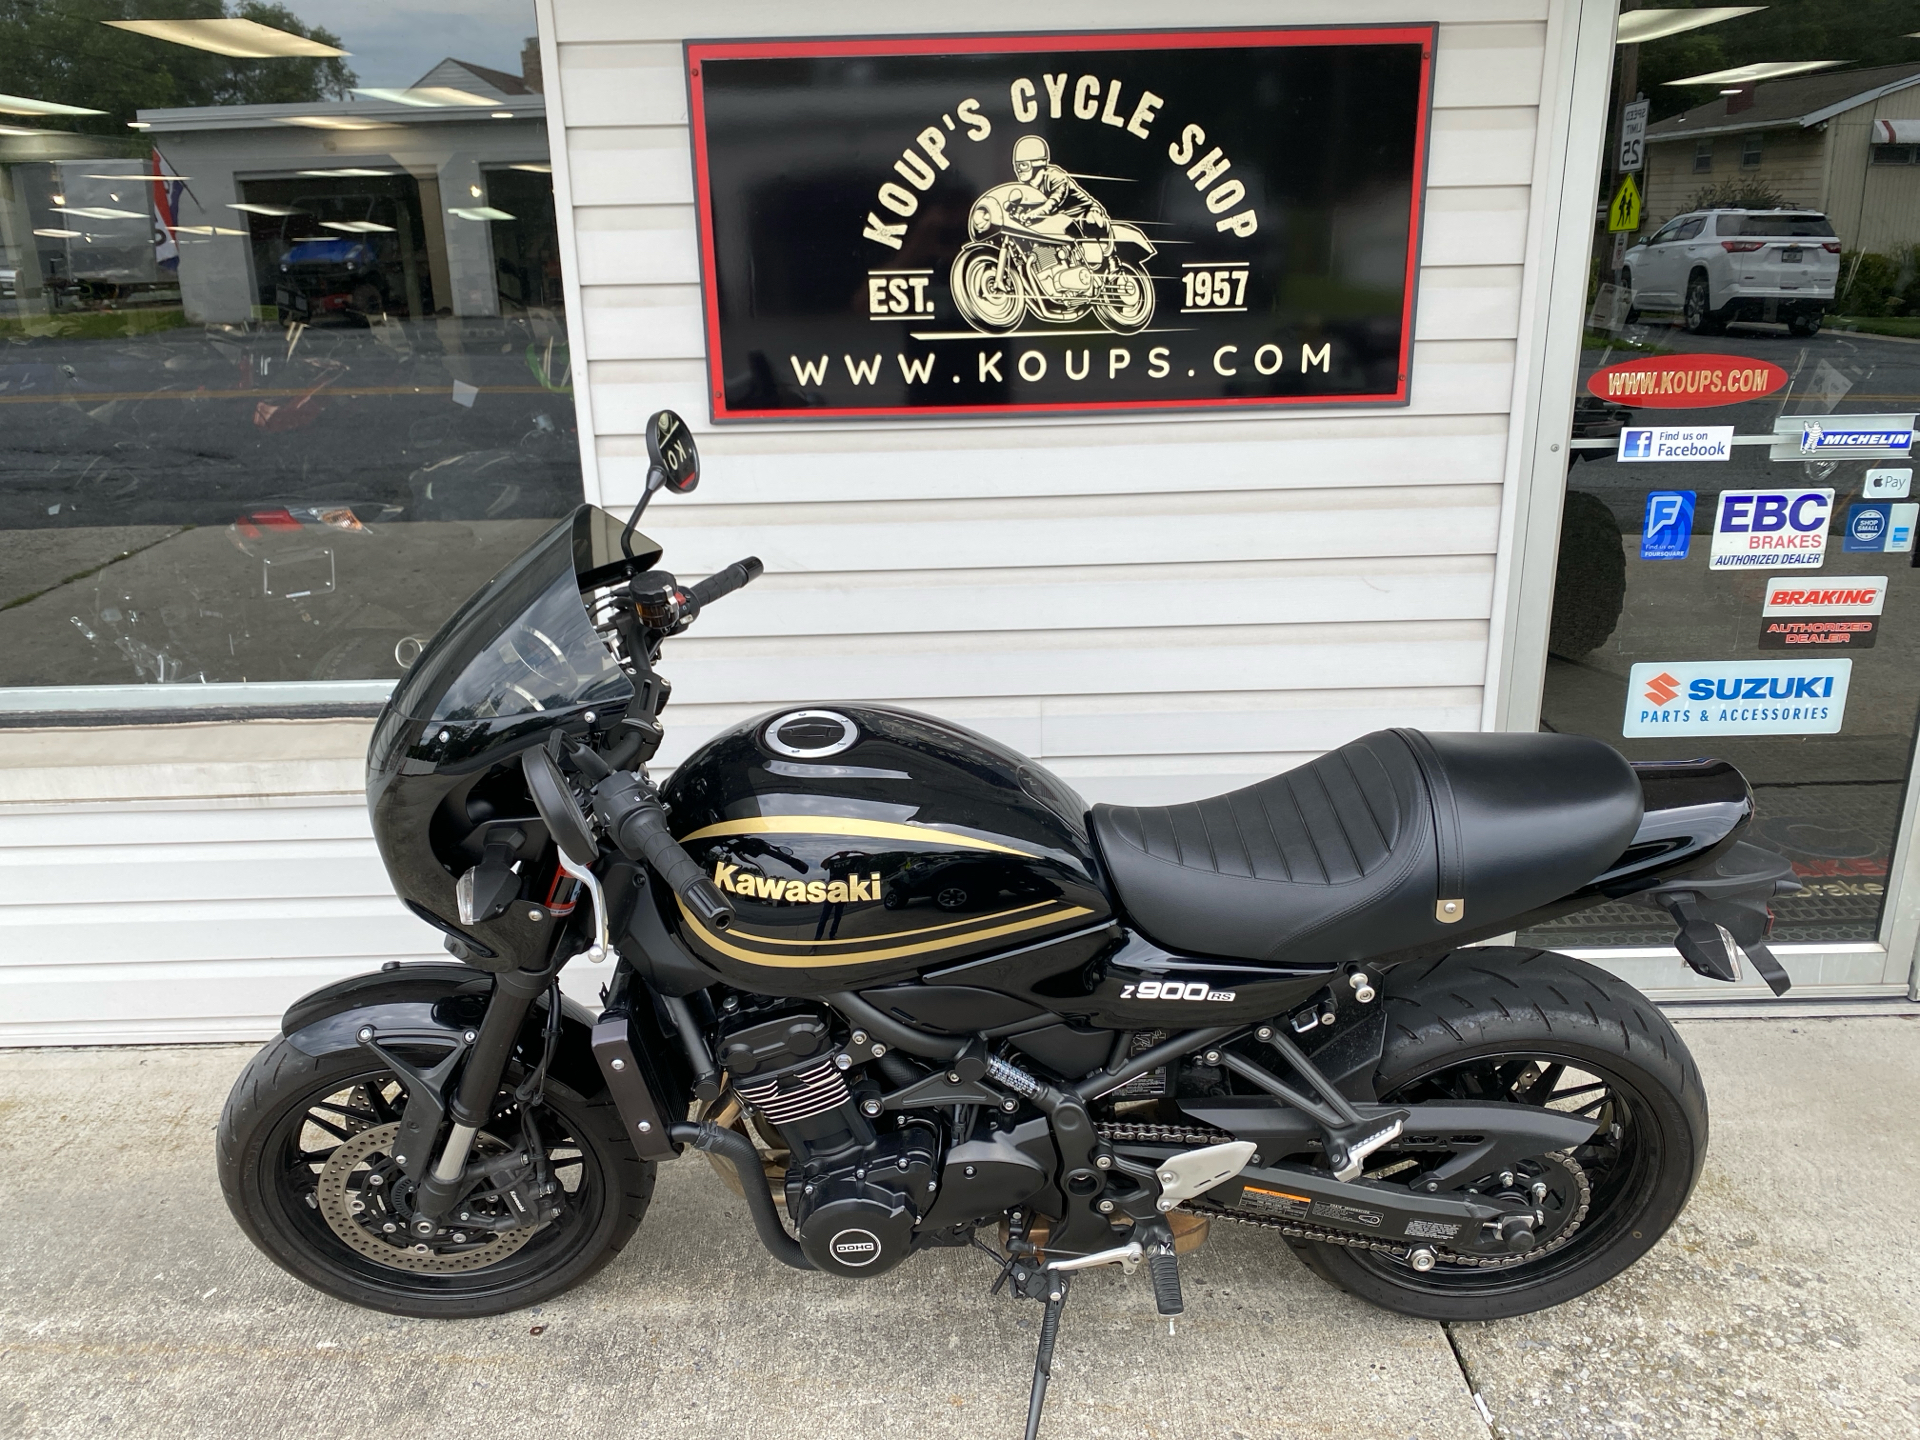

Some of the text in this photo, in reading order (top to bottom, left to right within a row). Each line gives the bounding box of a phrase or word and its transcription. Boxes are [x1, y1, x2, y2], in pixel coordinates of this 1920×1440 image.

[863, 73, 1259, 251] KOUP'S CYCLE SHOP
[868, 277, 935, 315] EST.
[1181, 270, 1249, 308] 1957
[790, 342, 1333, 387] WWW.KOUPS.COM
[1608, 369, 1769, 396] WWW.KOUPS.COM
[1659, 431, 1709, 441] Find us on
[1823, 434, 1910, 445] MICHELIN
[1657, 442, 1726, 457] Facebook
[1885, 475, 1907, 491] Pay
[1719, 493, 1829, 533] EBC
[1749, 534, 1822, 550] BRAKES
[1715, 553, 1821, 566] AUTHORIZED DEALER
[1768, 588, 1878, 607] BRAKING
[1766, 621, 1873, 633] AUTHORIZED
[1785, 633, 1851, 644] DEALER
[1688, 676, 1835, 701] SUZUKI
[1640, 706, 1829, 723] PARTS & ACCESSORIES
[713, 860, 882, 904] Kawasaki
